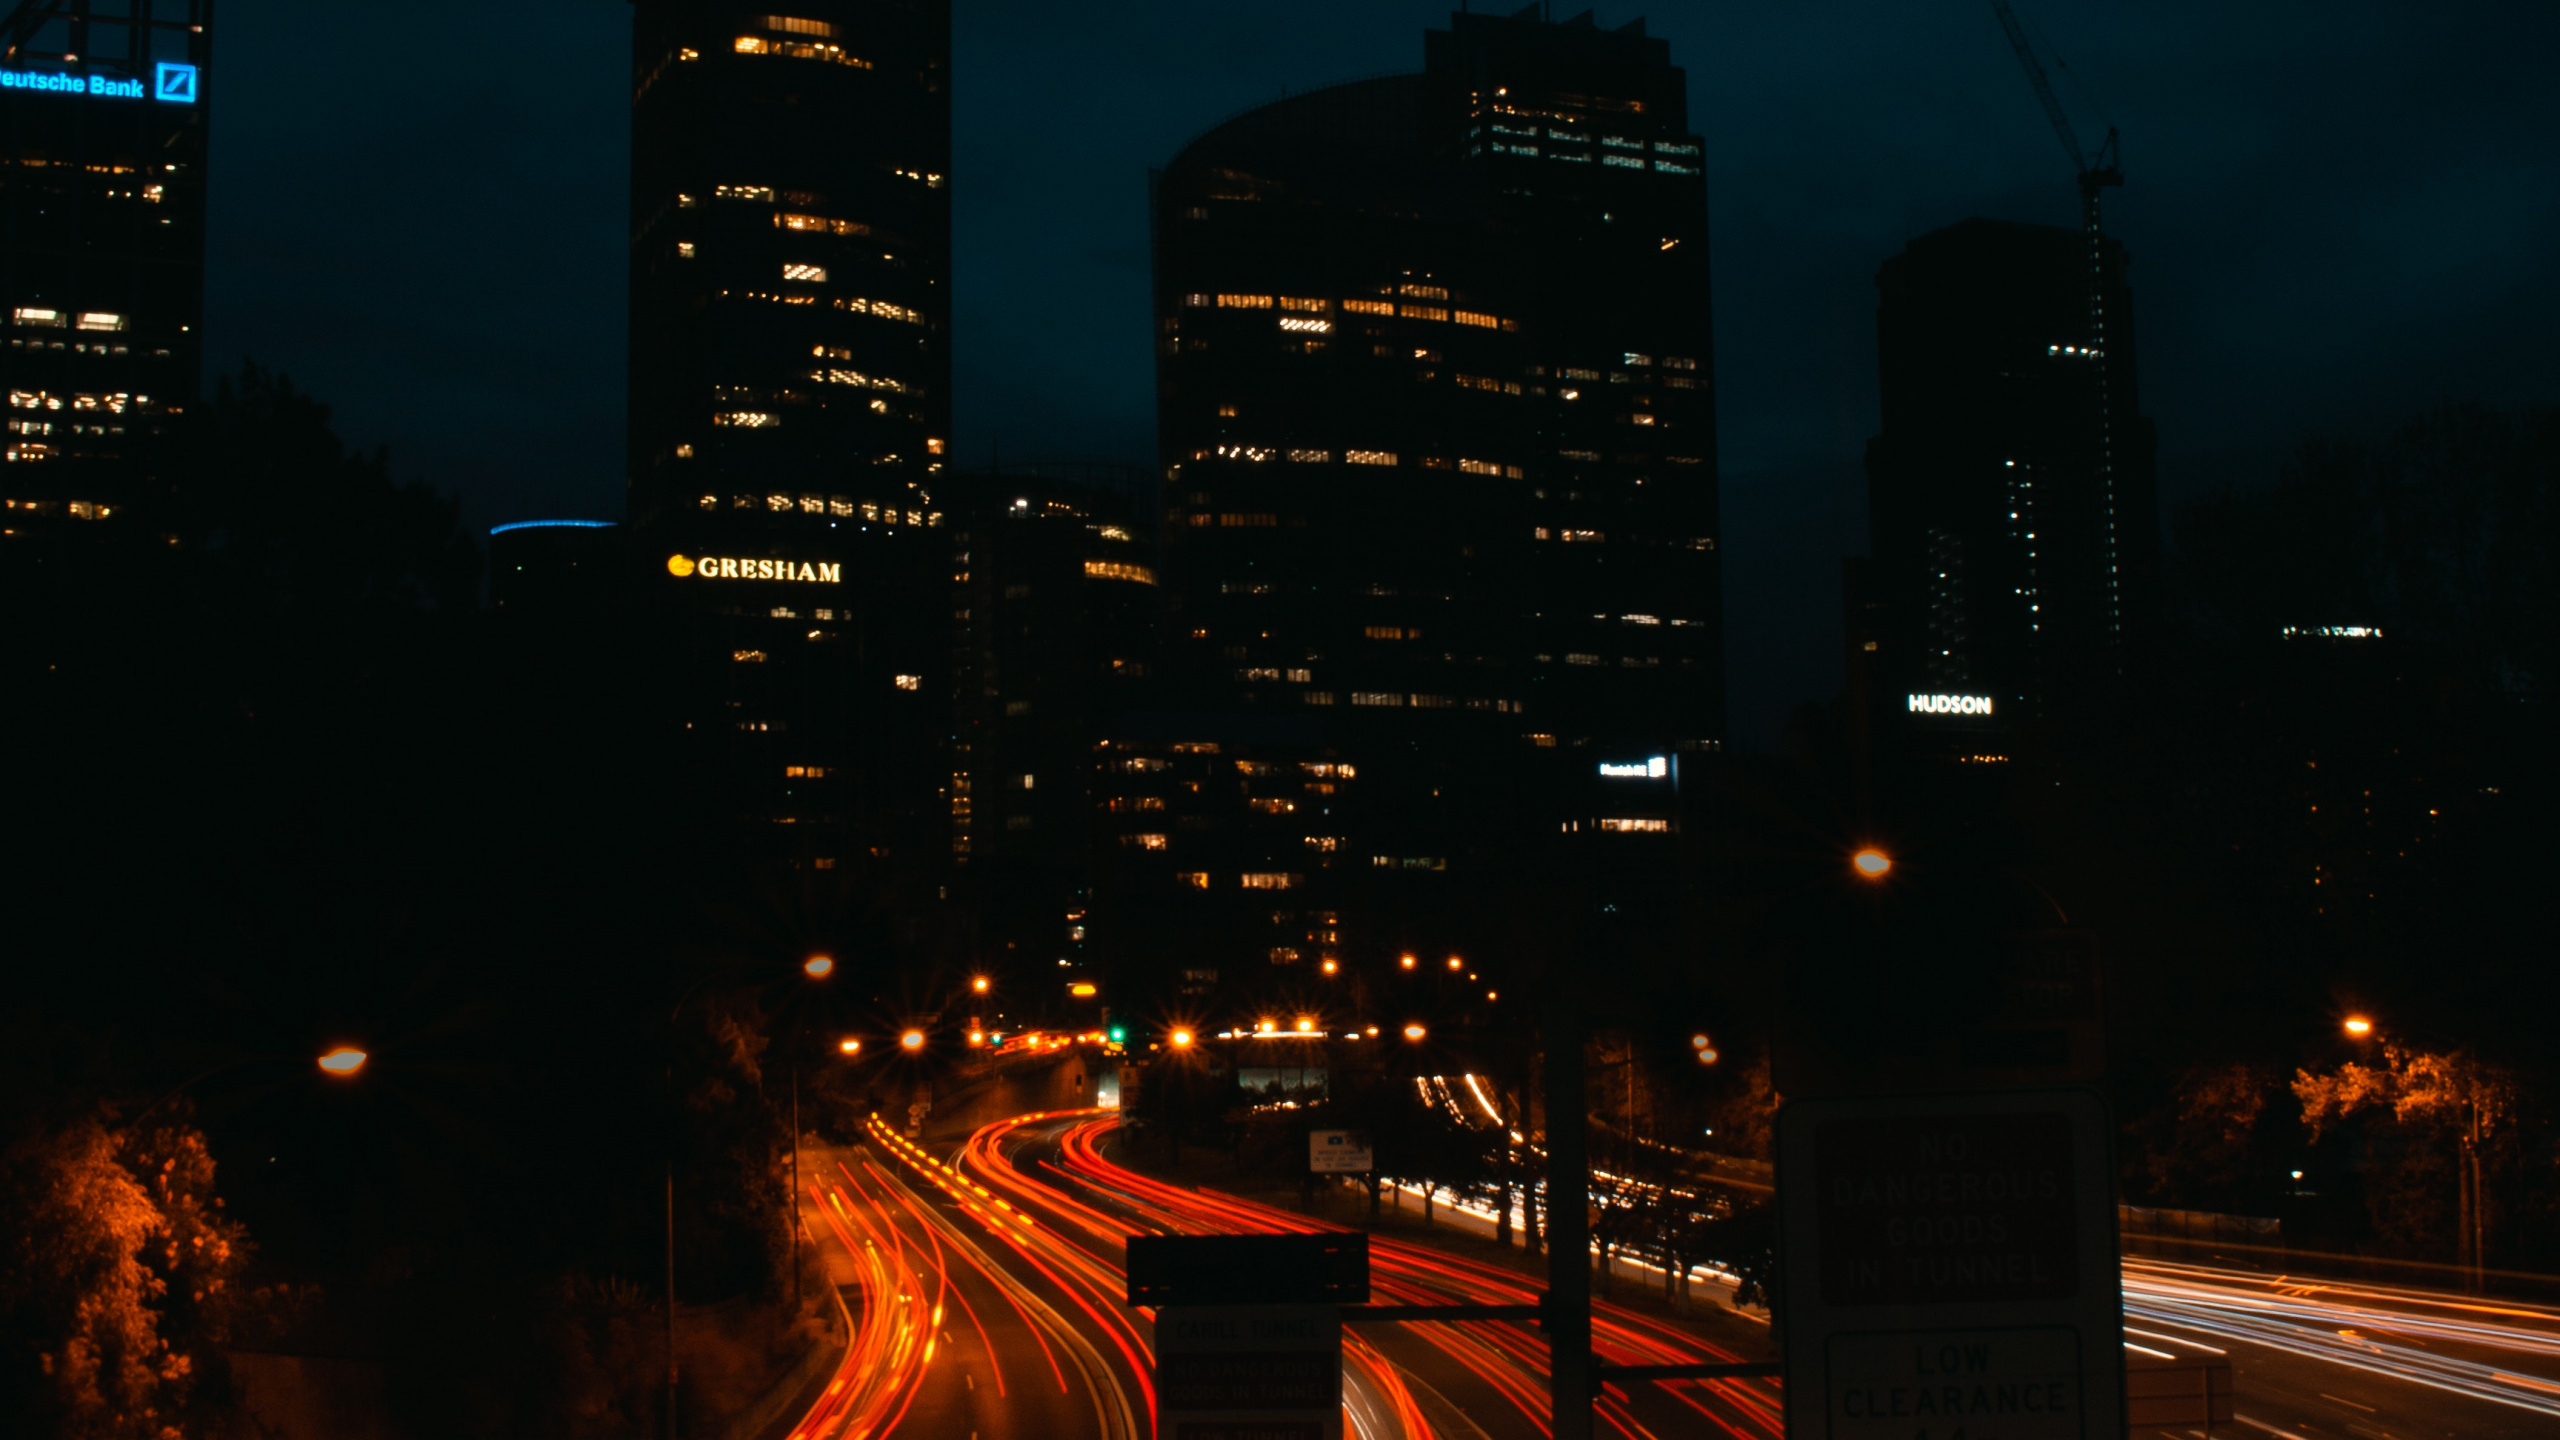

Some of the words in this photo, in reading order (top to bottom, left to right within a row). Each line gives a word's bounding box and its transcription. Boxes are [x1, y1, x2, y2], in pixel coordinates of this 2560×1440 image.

[0, 70, 86, 93] eutsche
[89, 75, 144, 98] Bank
[698, 557, 841, 583] GRESHAM
[1908, 693, 1992, 715] HUDSON
[1919, 1133, 1967, 1163] NO
[1833, 1169, 2058, 1207] DANGEROUS
[1888, 1214, 2007, 1246] GOODS
[1849, 1258, 1881, 1289] IN
[1906, 1252, 2051, 1287] TUNNEL
[1177, 1320, 1239, 1340] CAHILL
[1251, 1318, 1319, 1339] TUNNEL
[1174, 1361, 1199, 1379] NO
[1209, 1360, 1322, 1378] DANGEROUS
[1915, 1344, 1990, 1376] LOW
[1168, 1384, 1226, 1401] GOODS
[1232, 1384, 1250, 1400] IN
[1259, 1383, 1329, 1400] TUNNEL
[1843, 1382, 2067, 1419] CLEARANCE
